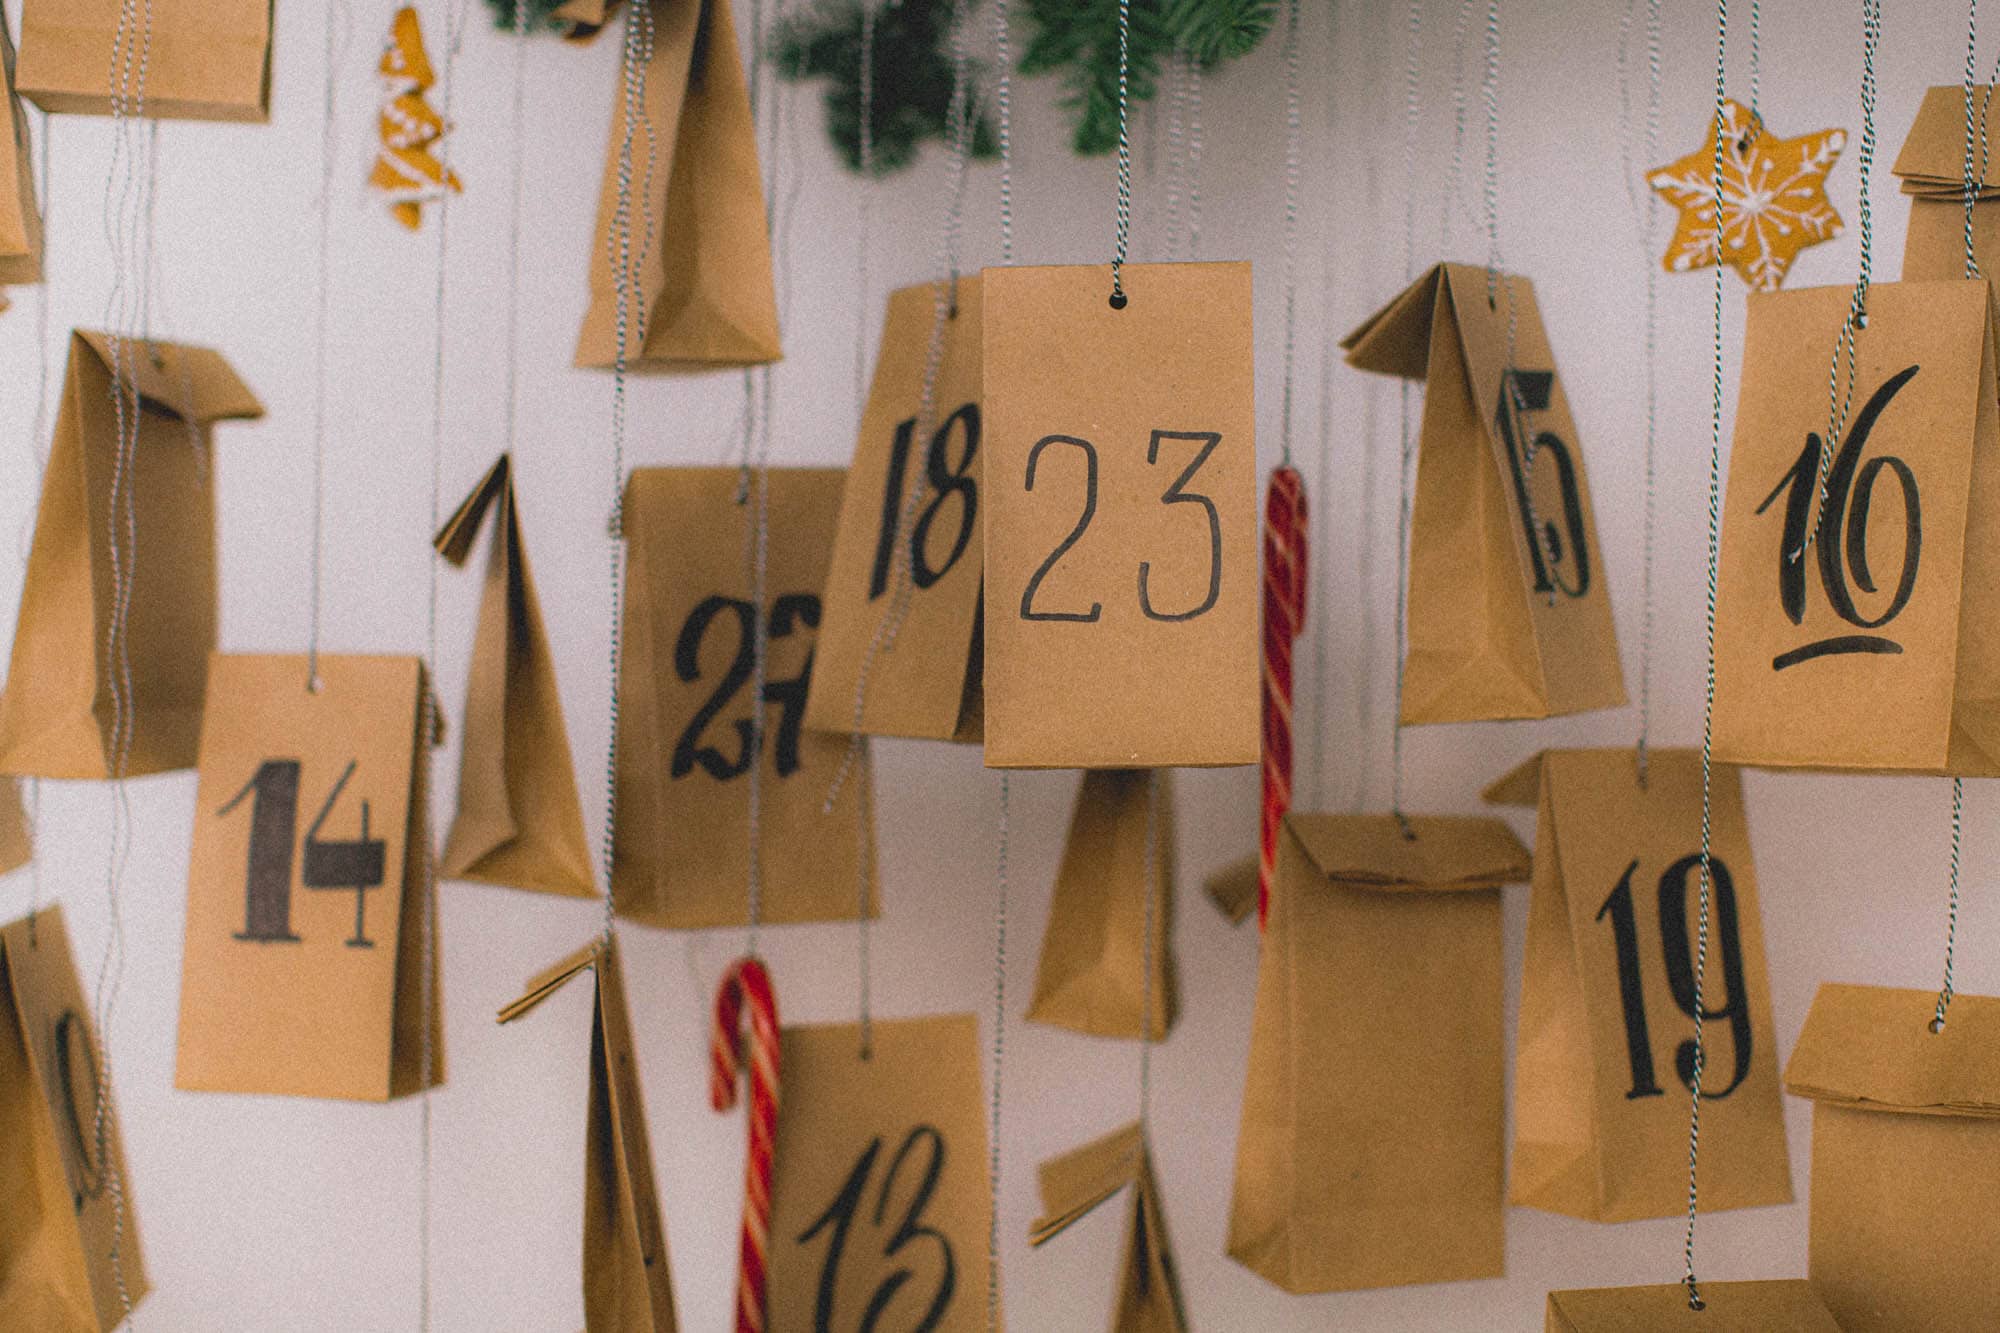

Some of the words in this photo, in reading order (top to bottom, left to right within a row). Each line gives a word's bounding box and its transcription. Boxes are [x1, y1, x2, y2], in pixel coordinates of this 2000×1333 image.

[869, 402, 982, 602] 18
[1020, 429, 1222, 623] 23
[1754, 364, 1921, 628] 16
[215, 758, 386, 948] 14
[1595, 852, 1752, 1100] 19
[796, 1124, 956, 1333] 13
